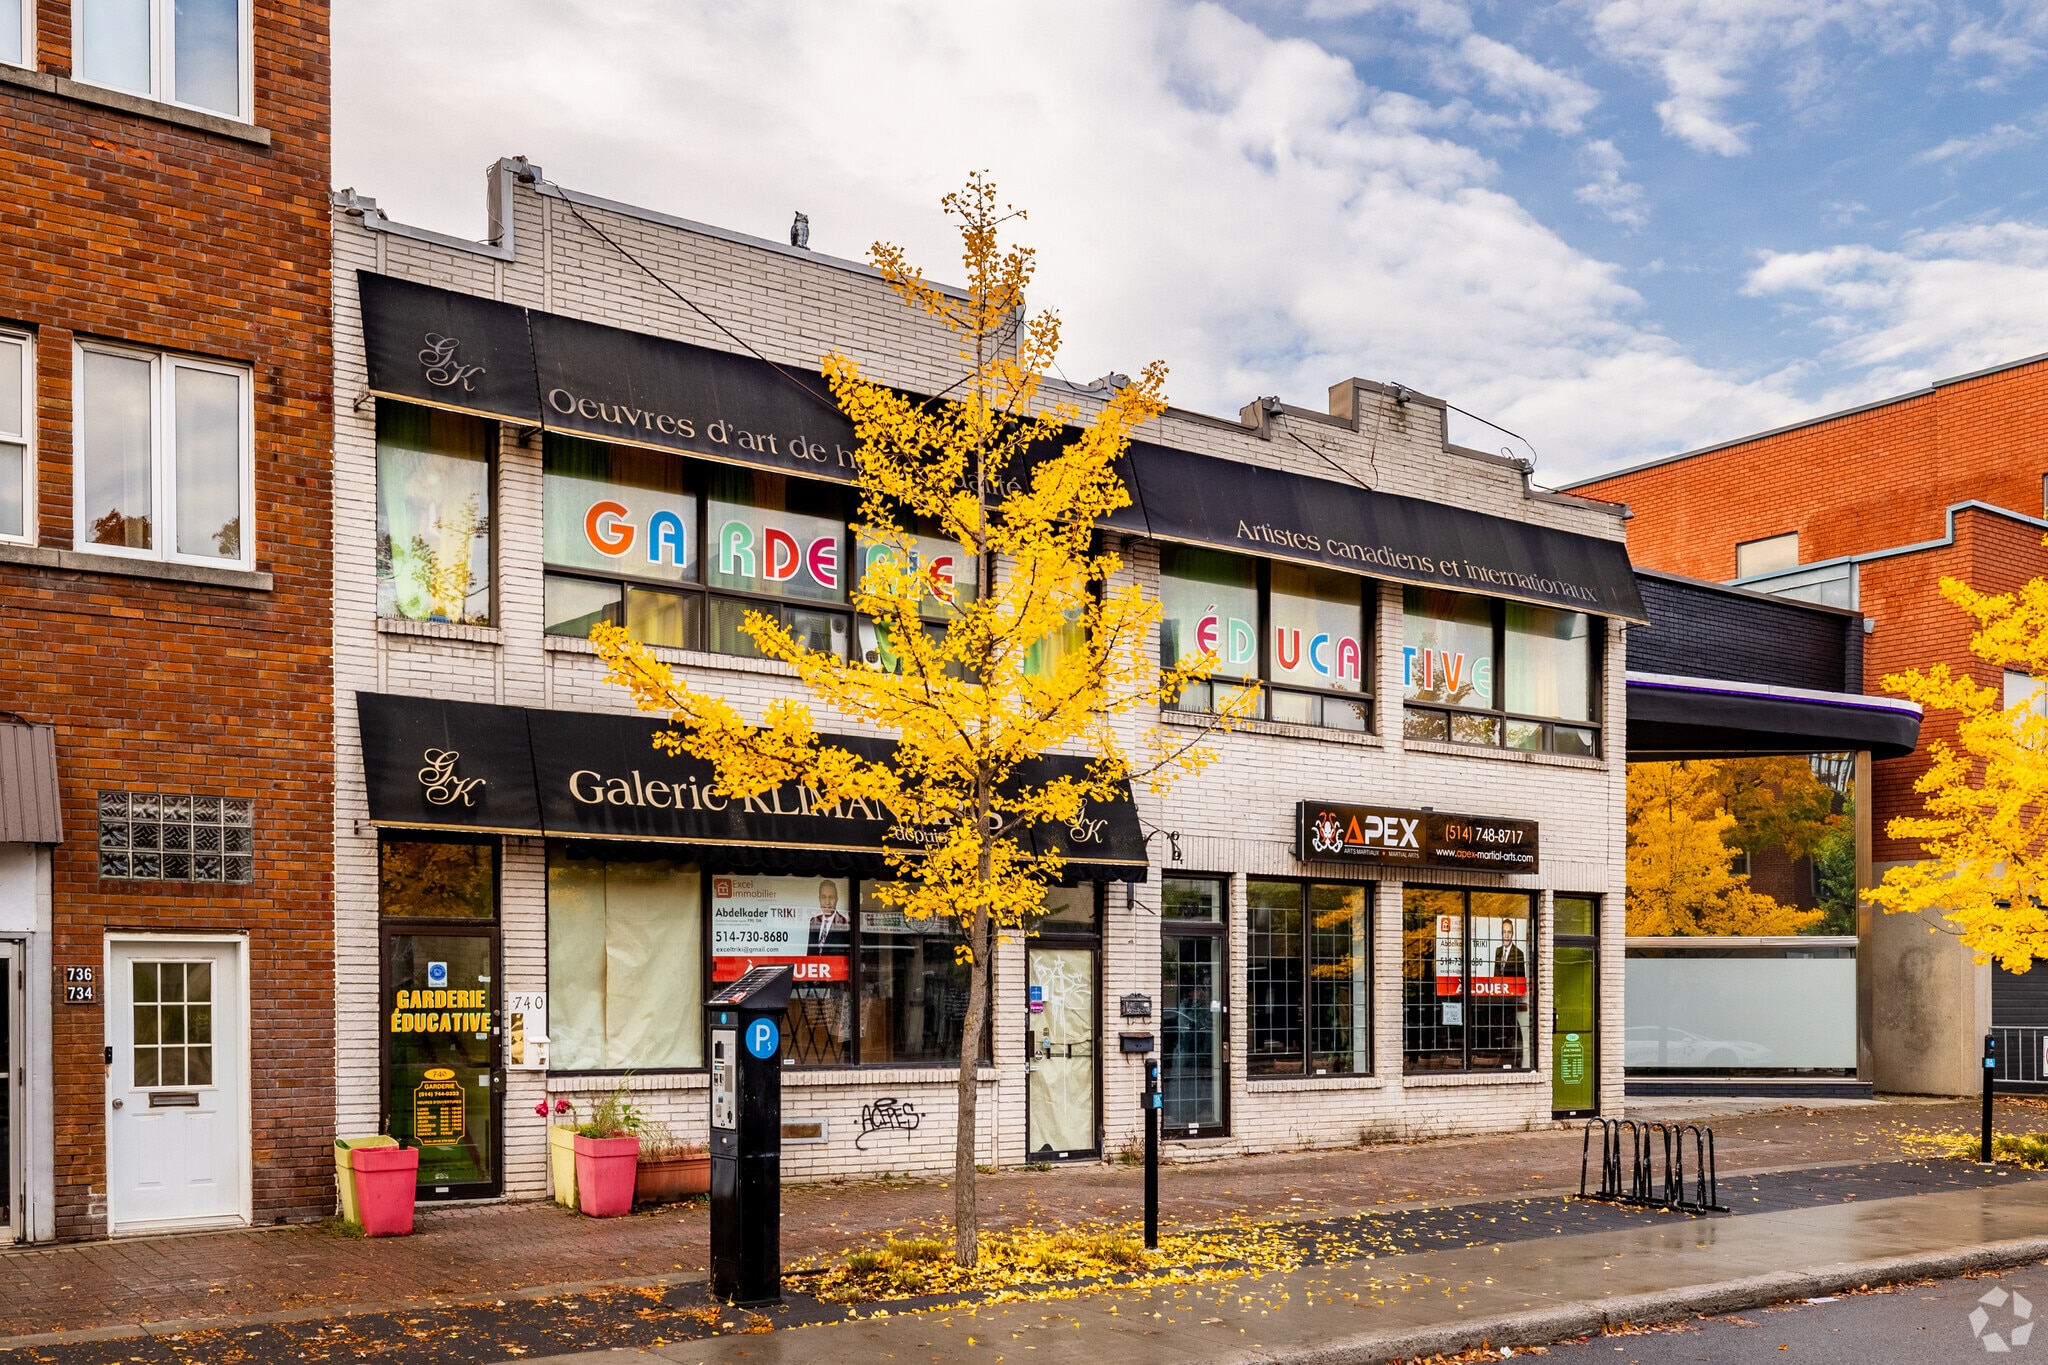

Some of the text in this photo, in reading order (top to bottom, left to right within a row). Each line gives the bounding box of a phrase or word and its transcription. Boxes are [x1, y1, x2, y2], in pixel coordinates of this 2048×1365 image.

[548, 388, 696, 438] Oeuvres
[789, 435, 828, 463] de
[1236, 519, 1597, 602] Artistes canadiens et internationaux
[569, 770, 728, 812] Galerie
[1344, 814, 1419, 848] APEX
[1445, 824, 1523, 844] (514) 748-8717
[1436, 848, 1533, 863] www.apex-martial-arts.com
[733, 880, 753, 888] Excel
[733, 890, 776, 898] immobilier
[715, 908, 796, 918] Abdelkader TRIKI
[715, 931, 788, 942] 514-730-8680
[67, 967, 92, 981] 736
[793, 963, 831, 978] UER
[67, 986, 93, 1000] 734
[397, 989, 486, 1009] GARDERIE
[514, 996, 543, 1010] 740
[391, 1007, 492, 1033] ÉDUCATIVE
